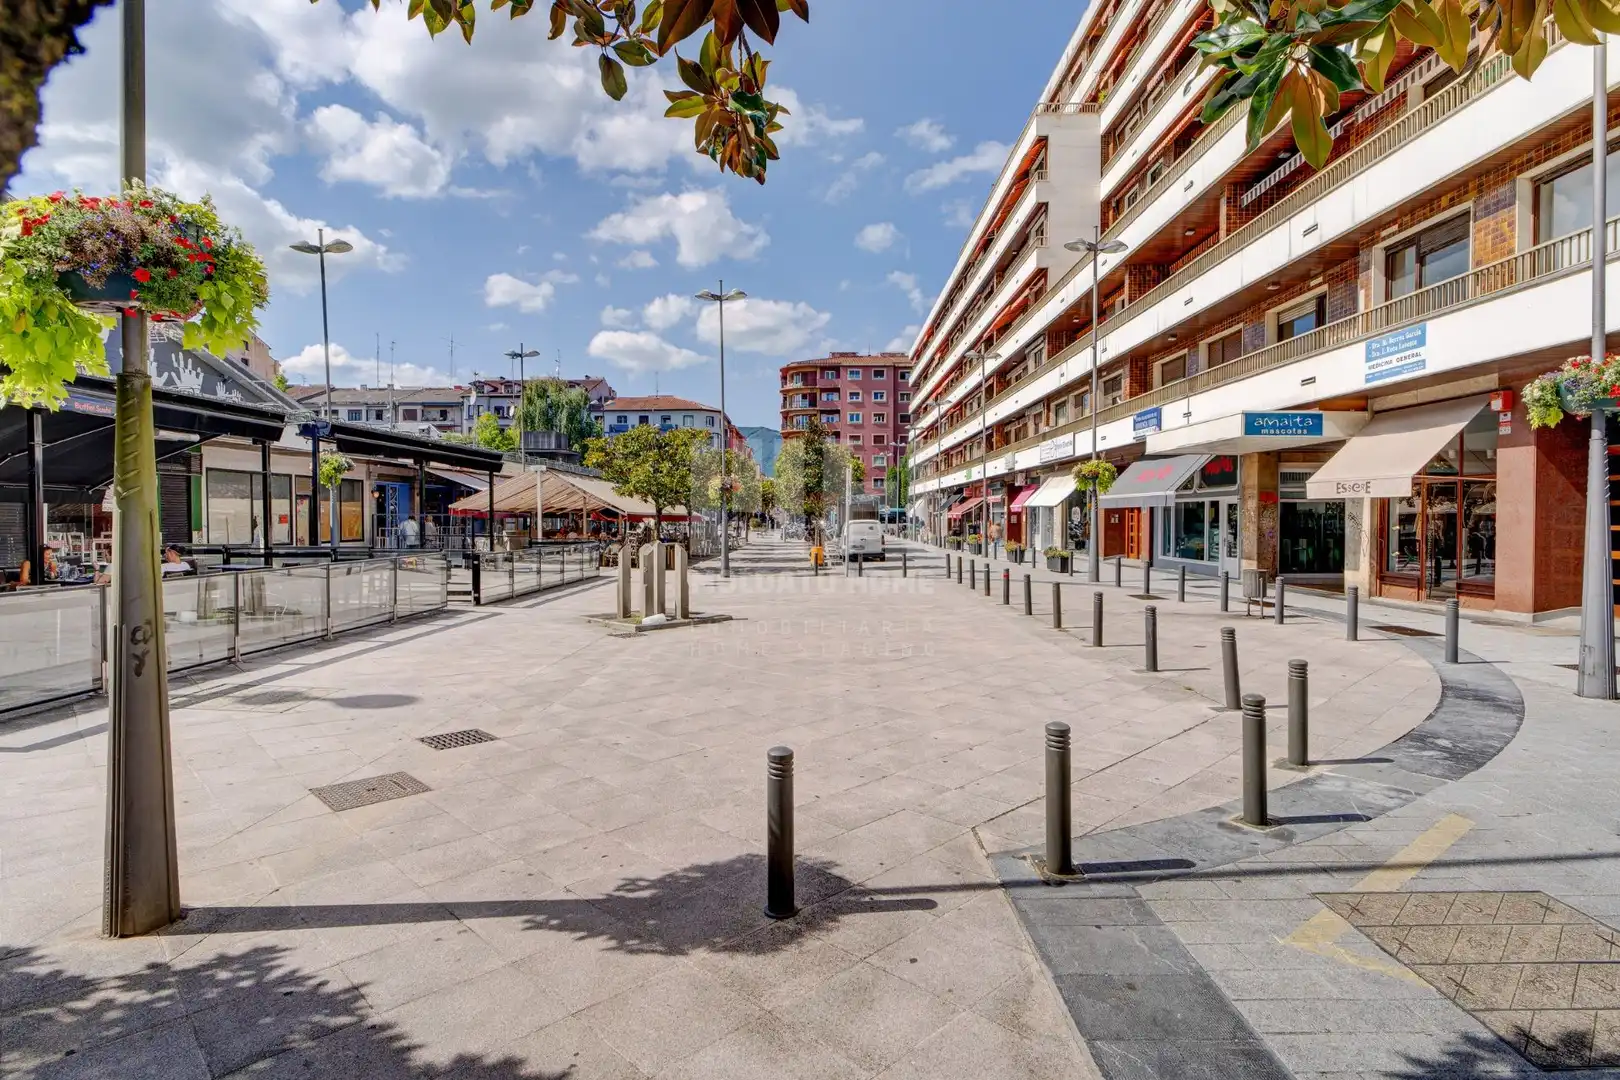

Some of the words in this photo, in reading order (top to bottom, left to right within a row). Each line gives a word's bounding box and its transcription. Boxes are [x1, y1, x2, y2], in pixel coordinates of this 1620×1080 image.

[1368, 359, 1393, 370] MEDICINA
[1396, 352, 1422, 363] GENERAL
[1261, 427, 1307, 435] mascotas
